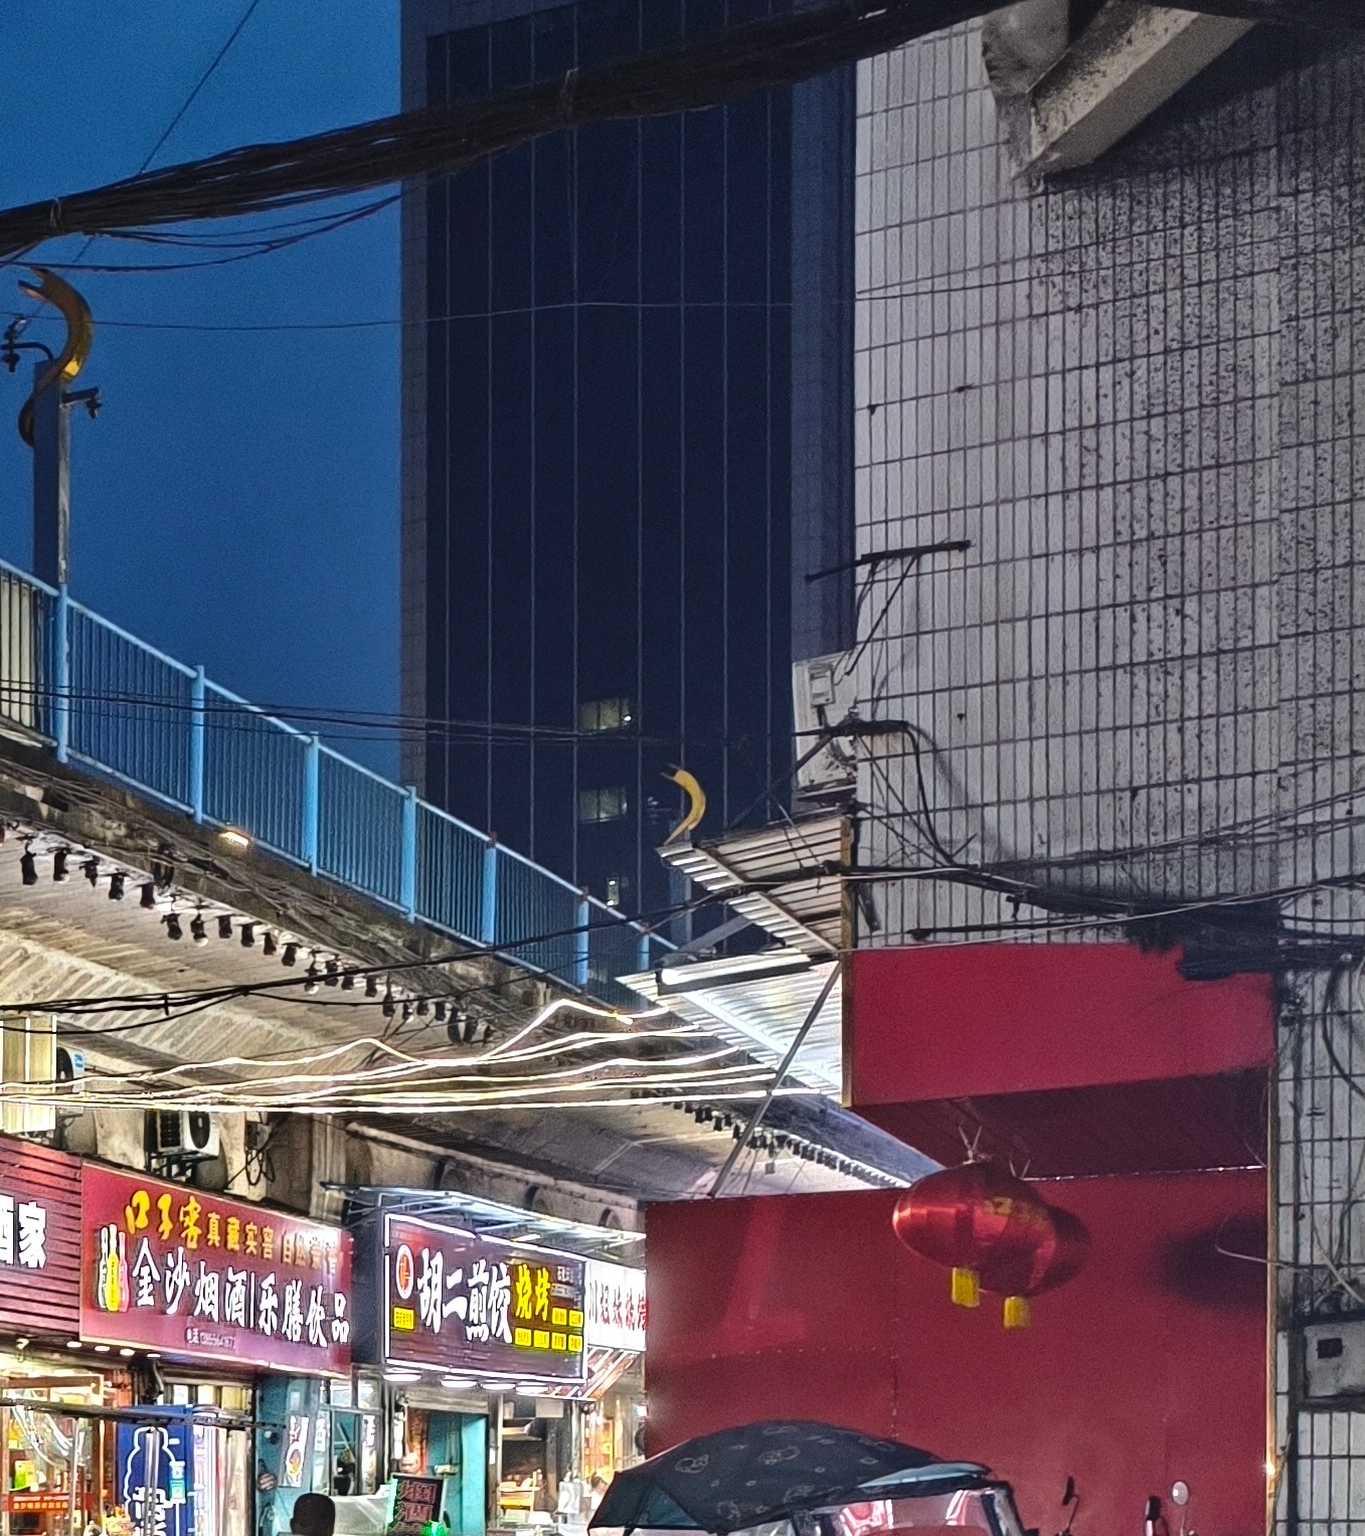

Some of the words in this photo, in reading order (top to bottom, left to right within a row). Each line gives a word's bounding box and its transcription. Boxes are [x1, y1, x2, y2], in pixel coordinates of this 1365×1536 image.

[416, 1246, 513, 1344] 胡二煎饺
[514, 1263, 551, 1321] 烧烤
